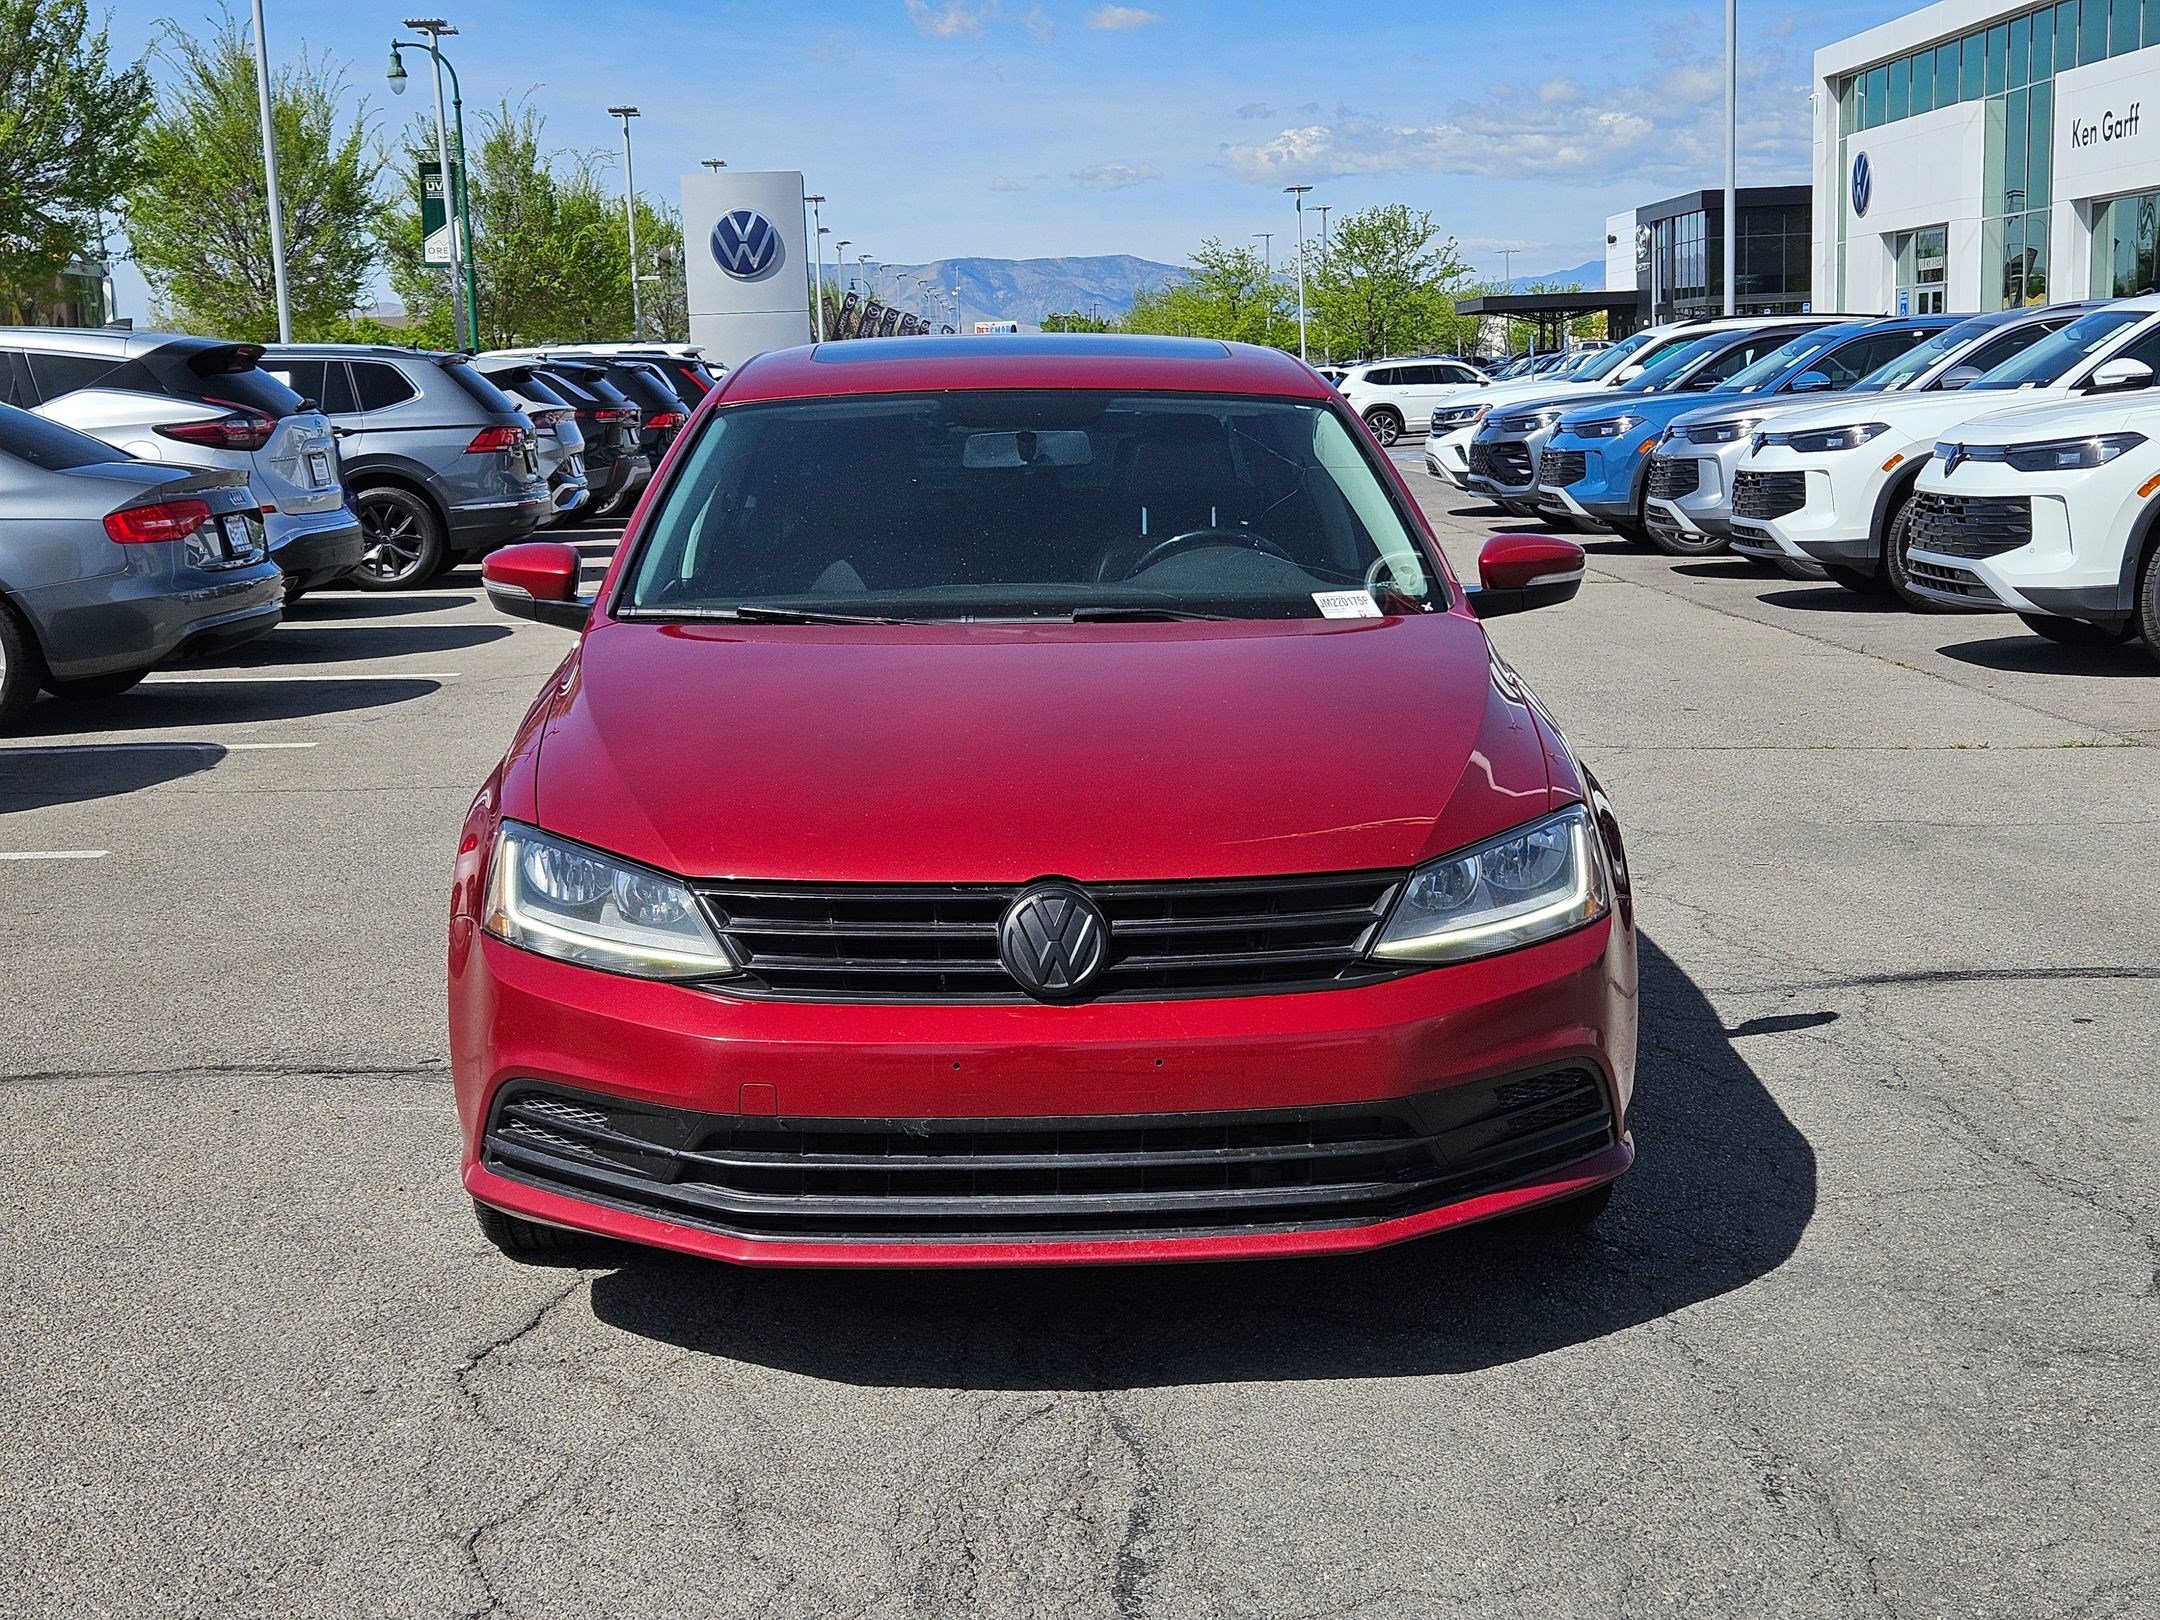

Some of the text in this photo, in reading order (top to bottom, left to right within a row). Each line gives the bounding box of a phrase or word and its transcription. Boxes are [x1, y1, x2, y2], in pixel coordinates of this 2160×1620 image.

[2071, 102, 2140, 149] Ken Garff
[426, 181, 443, 191] UV
[428, 246, 449, 255] ORE
[710, 209, 776, 276] VW
[1004, 892, 1102, 990] VW
